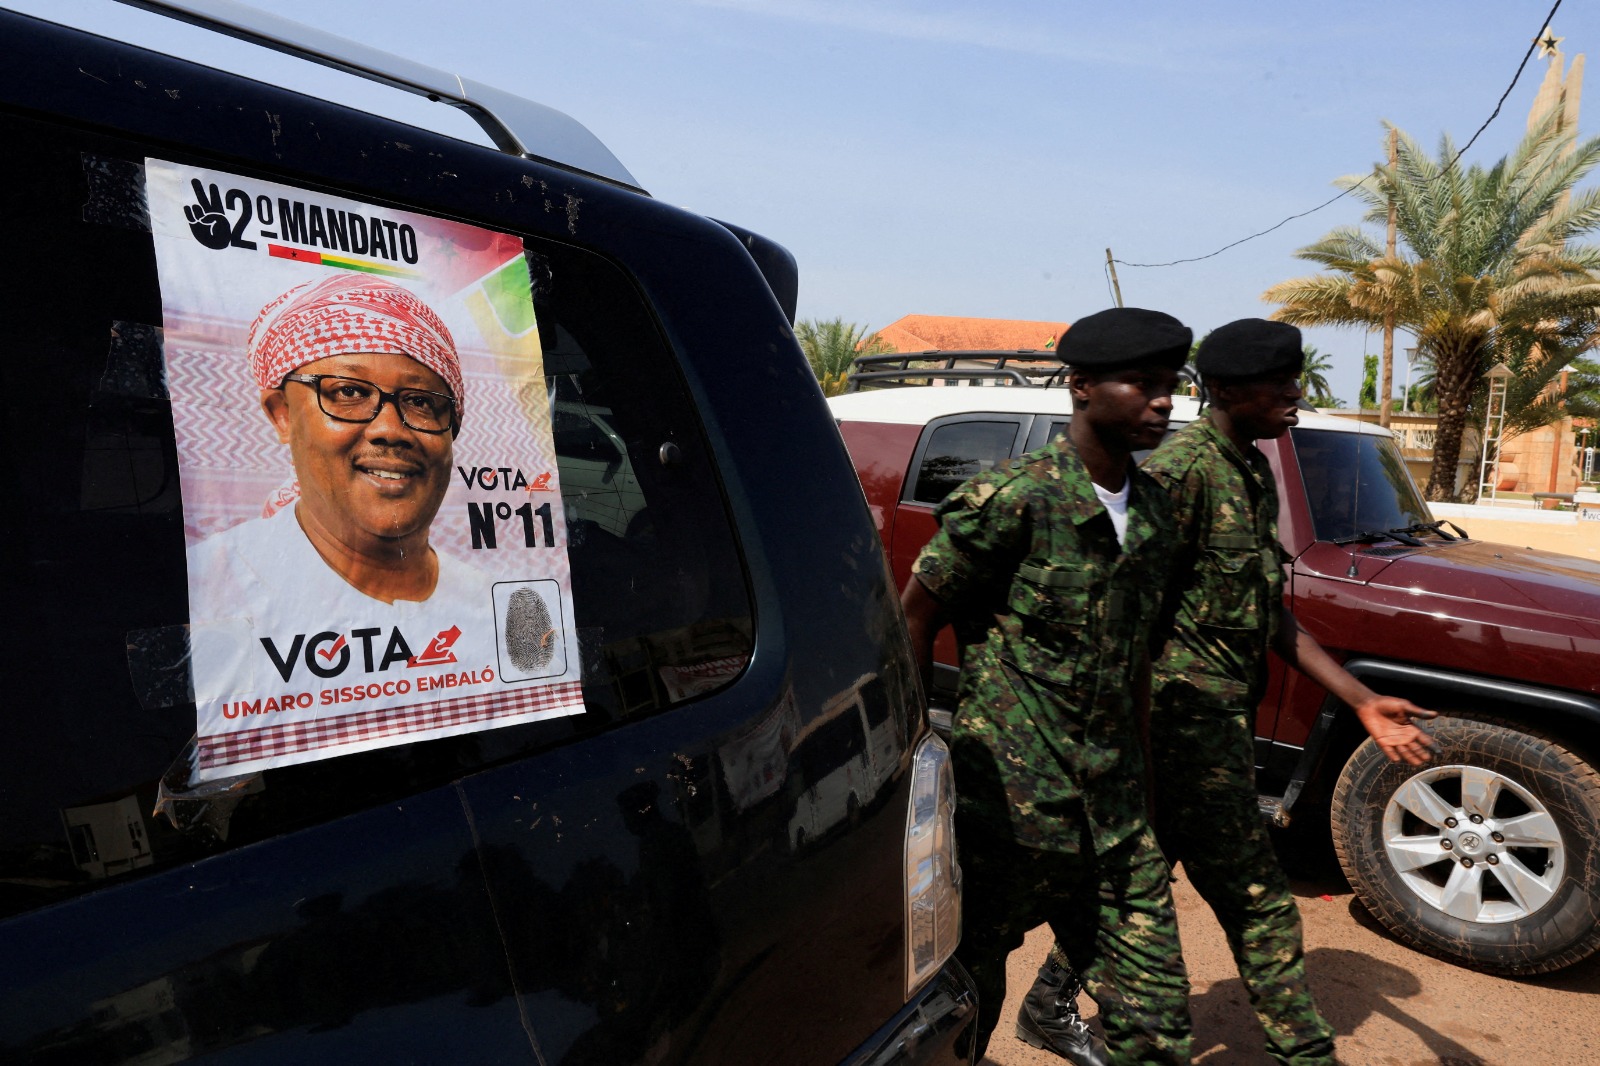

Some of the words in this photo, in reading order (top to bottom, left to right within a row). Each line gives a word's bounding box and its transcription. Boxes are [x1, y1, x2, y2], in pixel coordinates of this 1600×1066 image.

[278, 197, 419, 265] MANDATO
[457, 466, 529, 491] VOTA
[259, 625, 415, 683] VOTA
[222, 692, 314, 719] UMARO
[320, 679, 411, 706] SISSOCO
[416, 664, 495, 691] EMBALÓ
